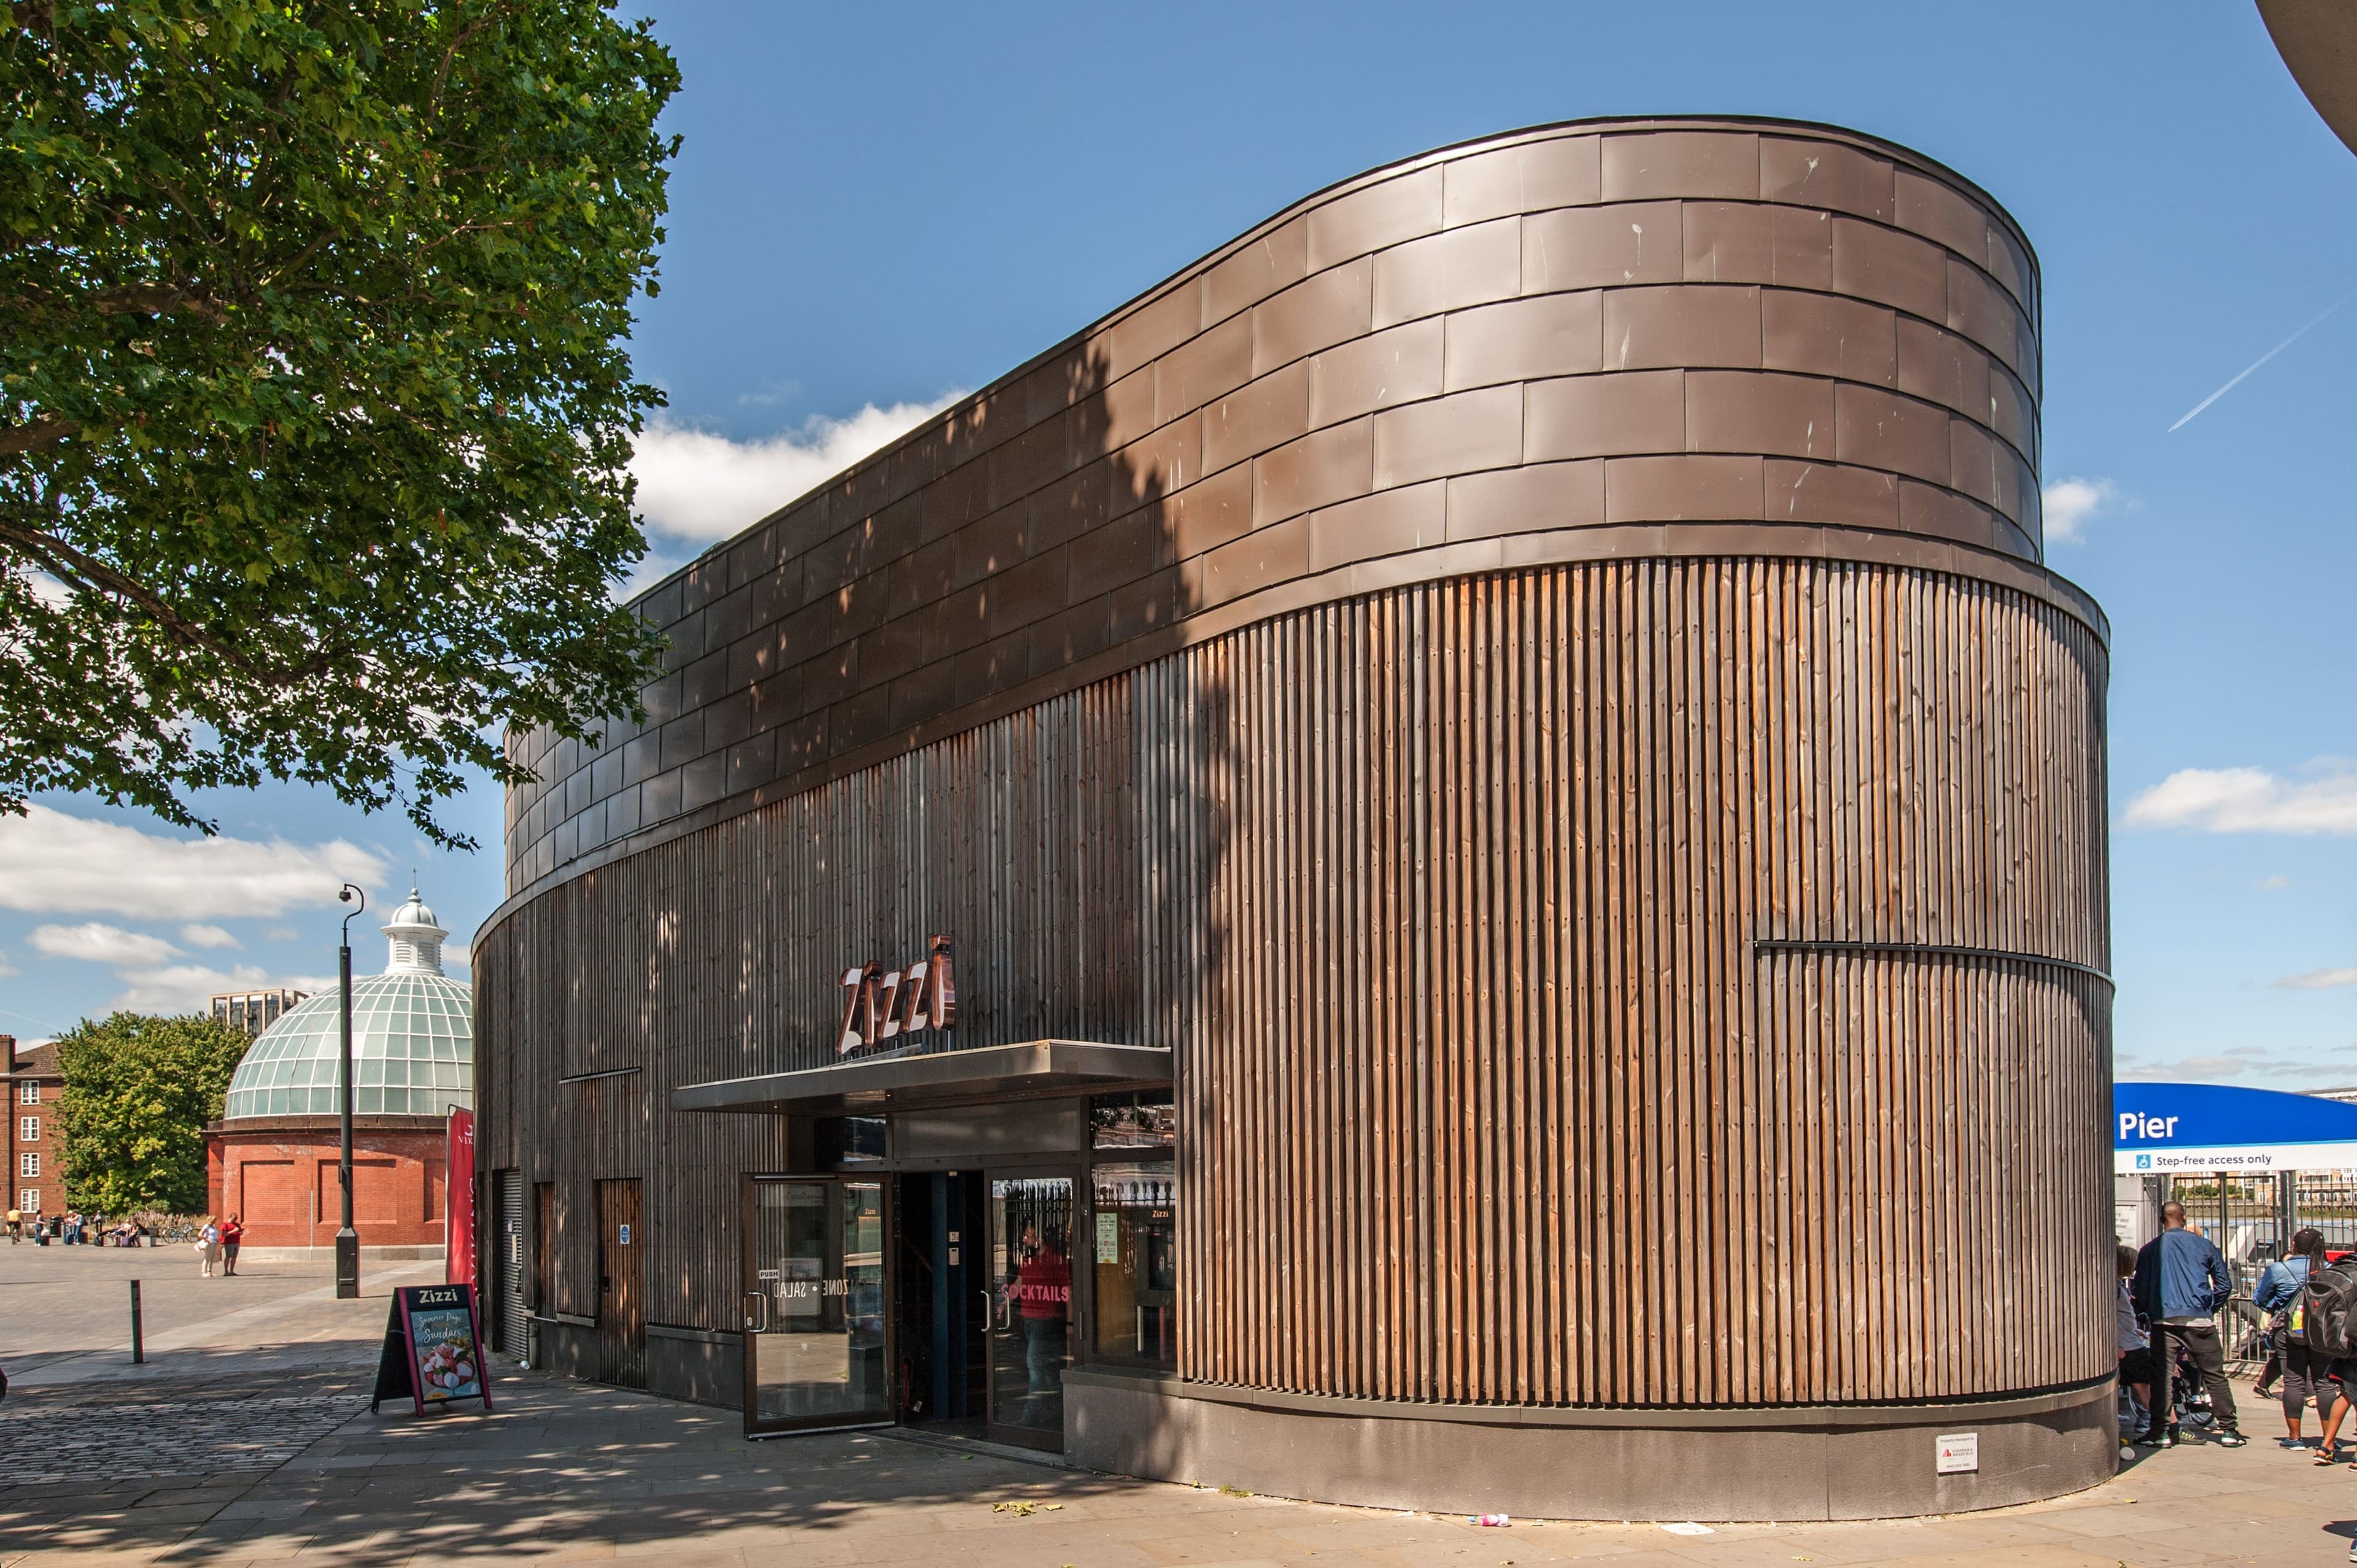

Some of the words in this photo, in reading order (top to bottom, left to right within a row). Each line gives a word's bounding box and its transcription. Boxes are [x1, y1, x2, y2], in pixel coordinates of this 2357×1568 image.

[2119, 1111, 2178, 1140] Pier
[2156, 1156, 2205, 1167] Step-free
[2208, 1156, 2244, 1165] access
[2247, 1154, 2272, 1165] only
[419, 1289, 458, 1303] Zizzi
[1001, 1283, 1070, 1302] COCKTAILS
[419, 1315, 444, 1327] Summer
[446, 1312, 462, 1324] Days
[424, 1327, 462, 1343] Sundaes
